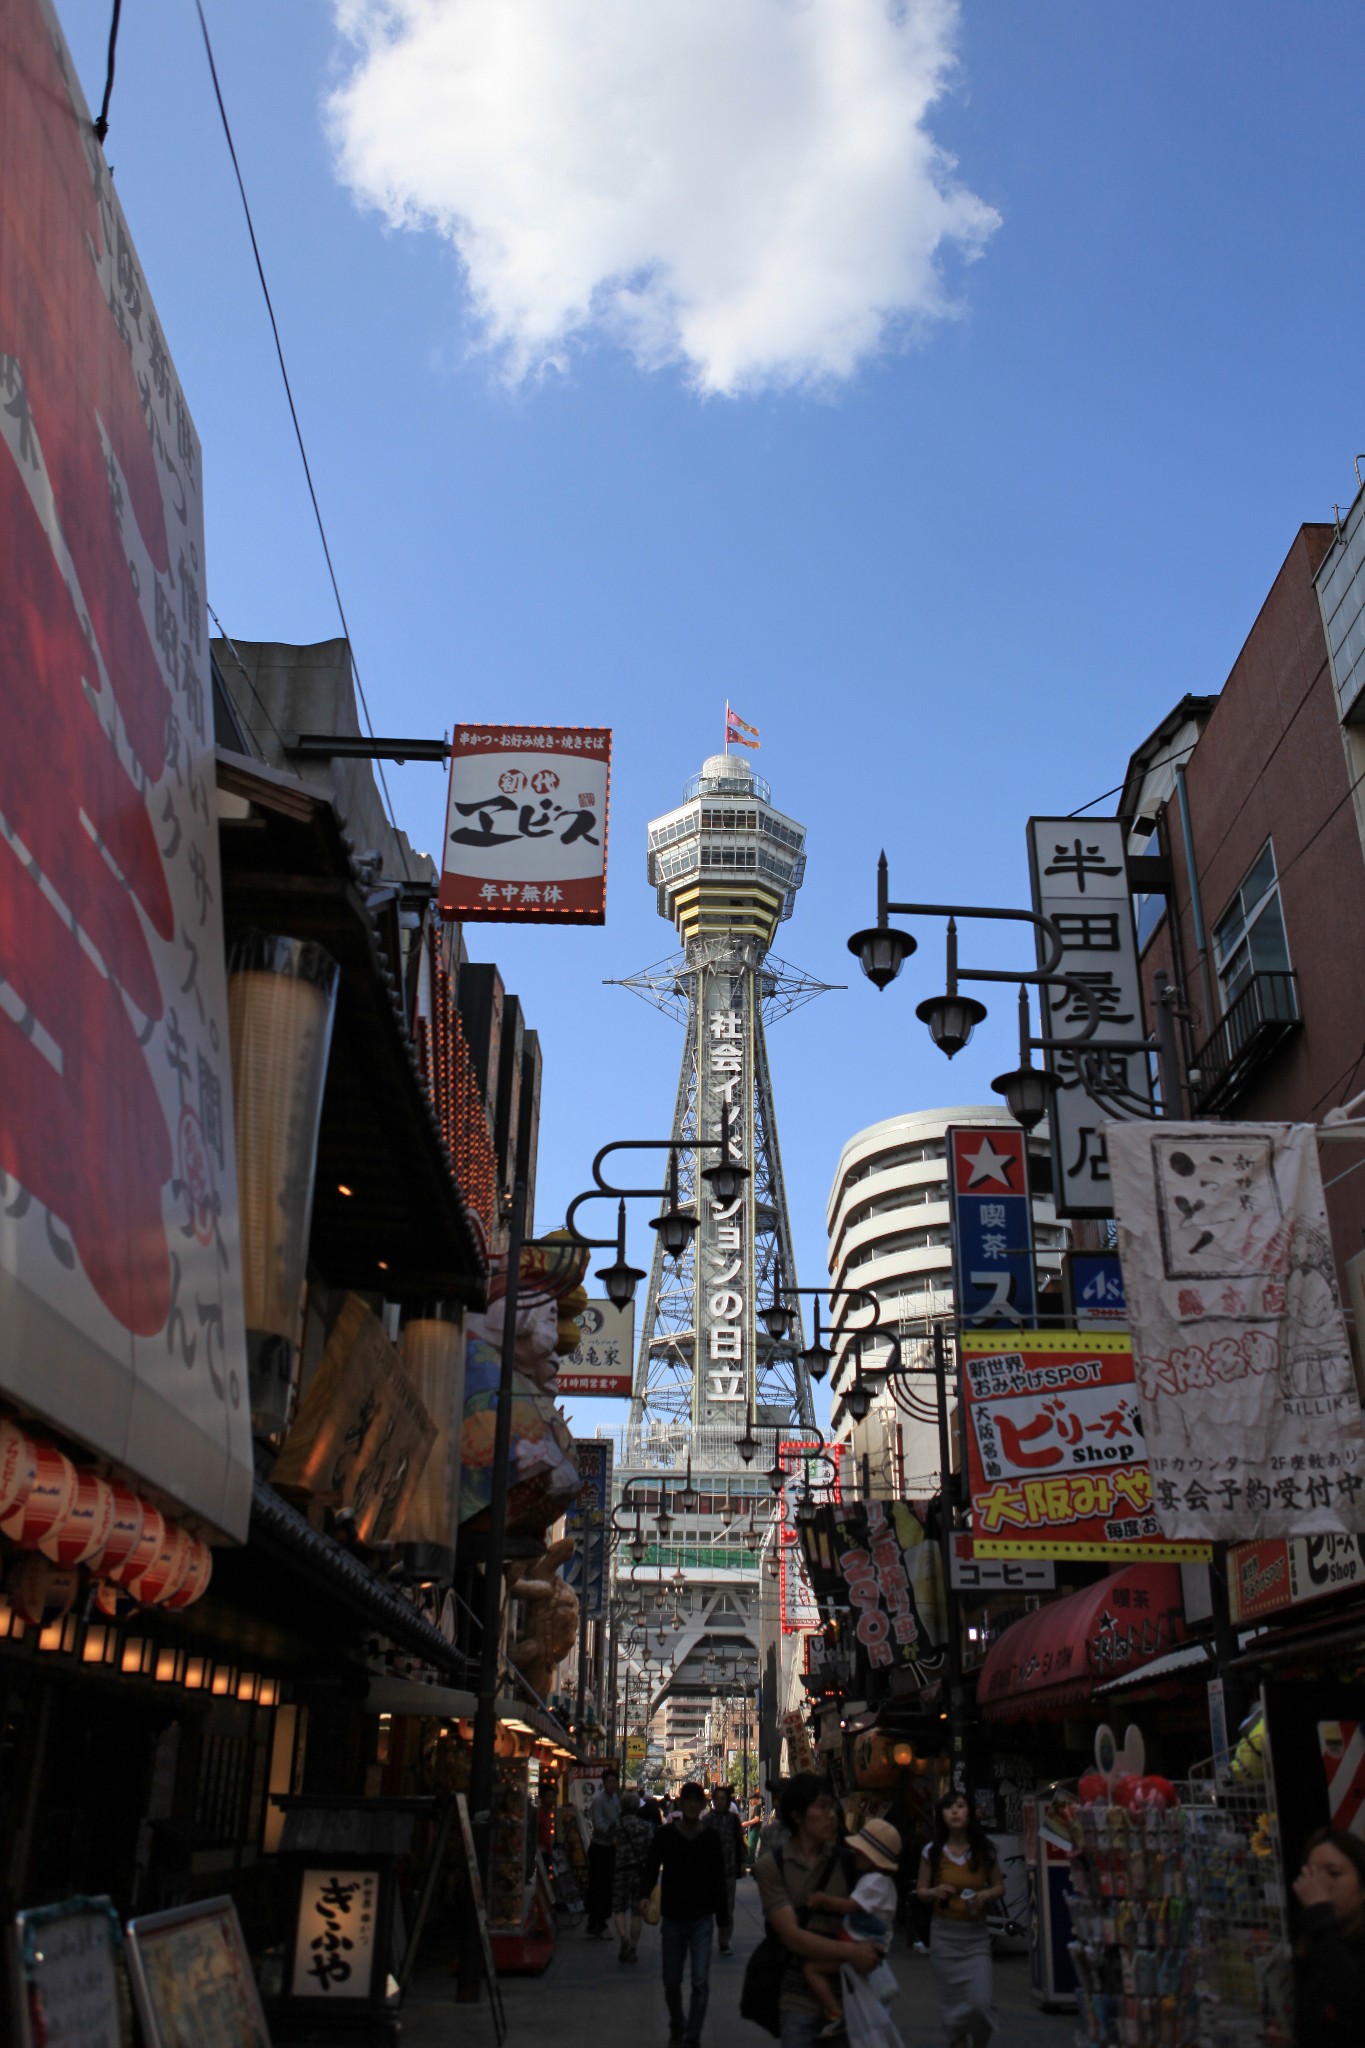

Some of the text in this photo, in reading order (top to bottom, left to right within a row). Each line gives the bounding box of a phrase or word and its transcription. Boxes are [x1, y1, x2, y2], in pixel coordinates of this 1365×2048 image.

[499, 769, 560, 794] 初代
[450, 796, 600, 847] エビス
[479, 882, 564, 904] 年中無休
[1043, 838, 1134, 1181] 半田屋酒店
[707, 1011, 745, 1402] 社会イノベションの日立
[980, 1204, 1008, 1260] 喫茶
[1083, 1270, 1125, 1301] As
[968, 1355, 1023, 1378] 新世界
[974, 1363, 1101, 1396] おみやげSPOT
[1140, 1330, 1281, 1401] 大阪名物
[976, 1406, 1002, 1478] 大阪名物
[993, 1395, 1133, 1468] ビリーズ
[1072, 1444, 1134, 1463] Shop
[1156, 1471, 1364, 1512] 宴会予約受付中
[960, 1563, 1045, 1586] コーヒー
[1330, 1560, 1357, 1582] Shop
[841, 1549, 893, 1669] 290円
[1112, 1588, 1150, 1609] 喫茶
[307, 1877, 360, 1990] ぎふや
